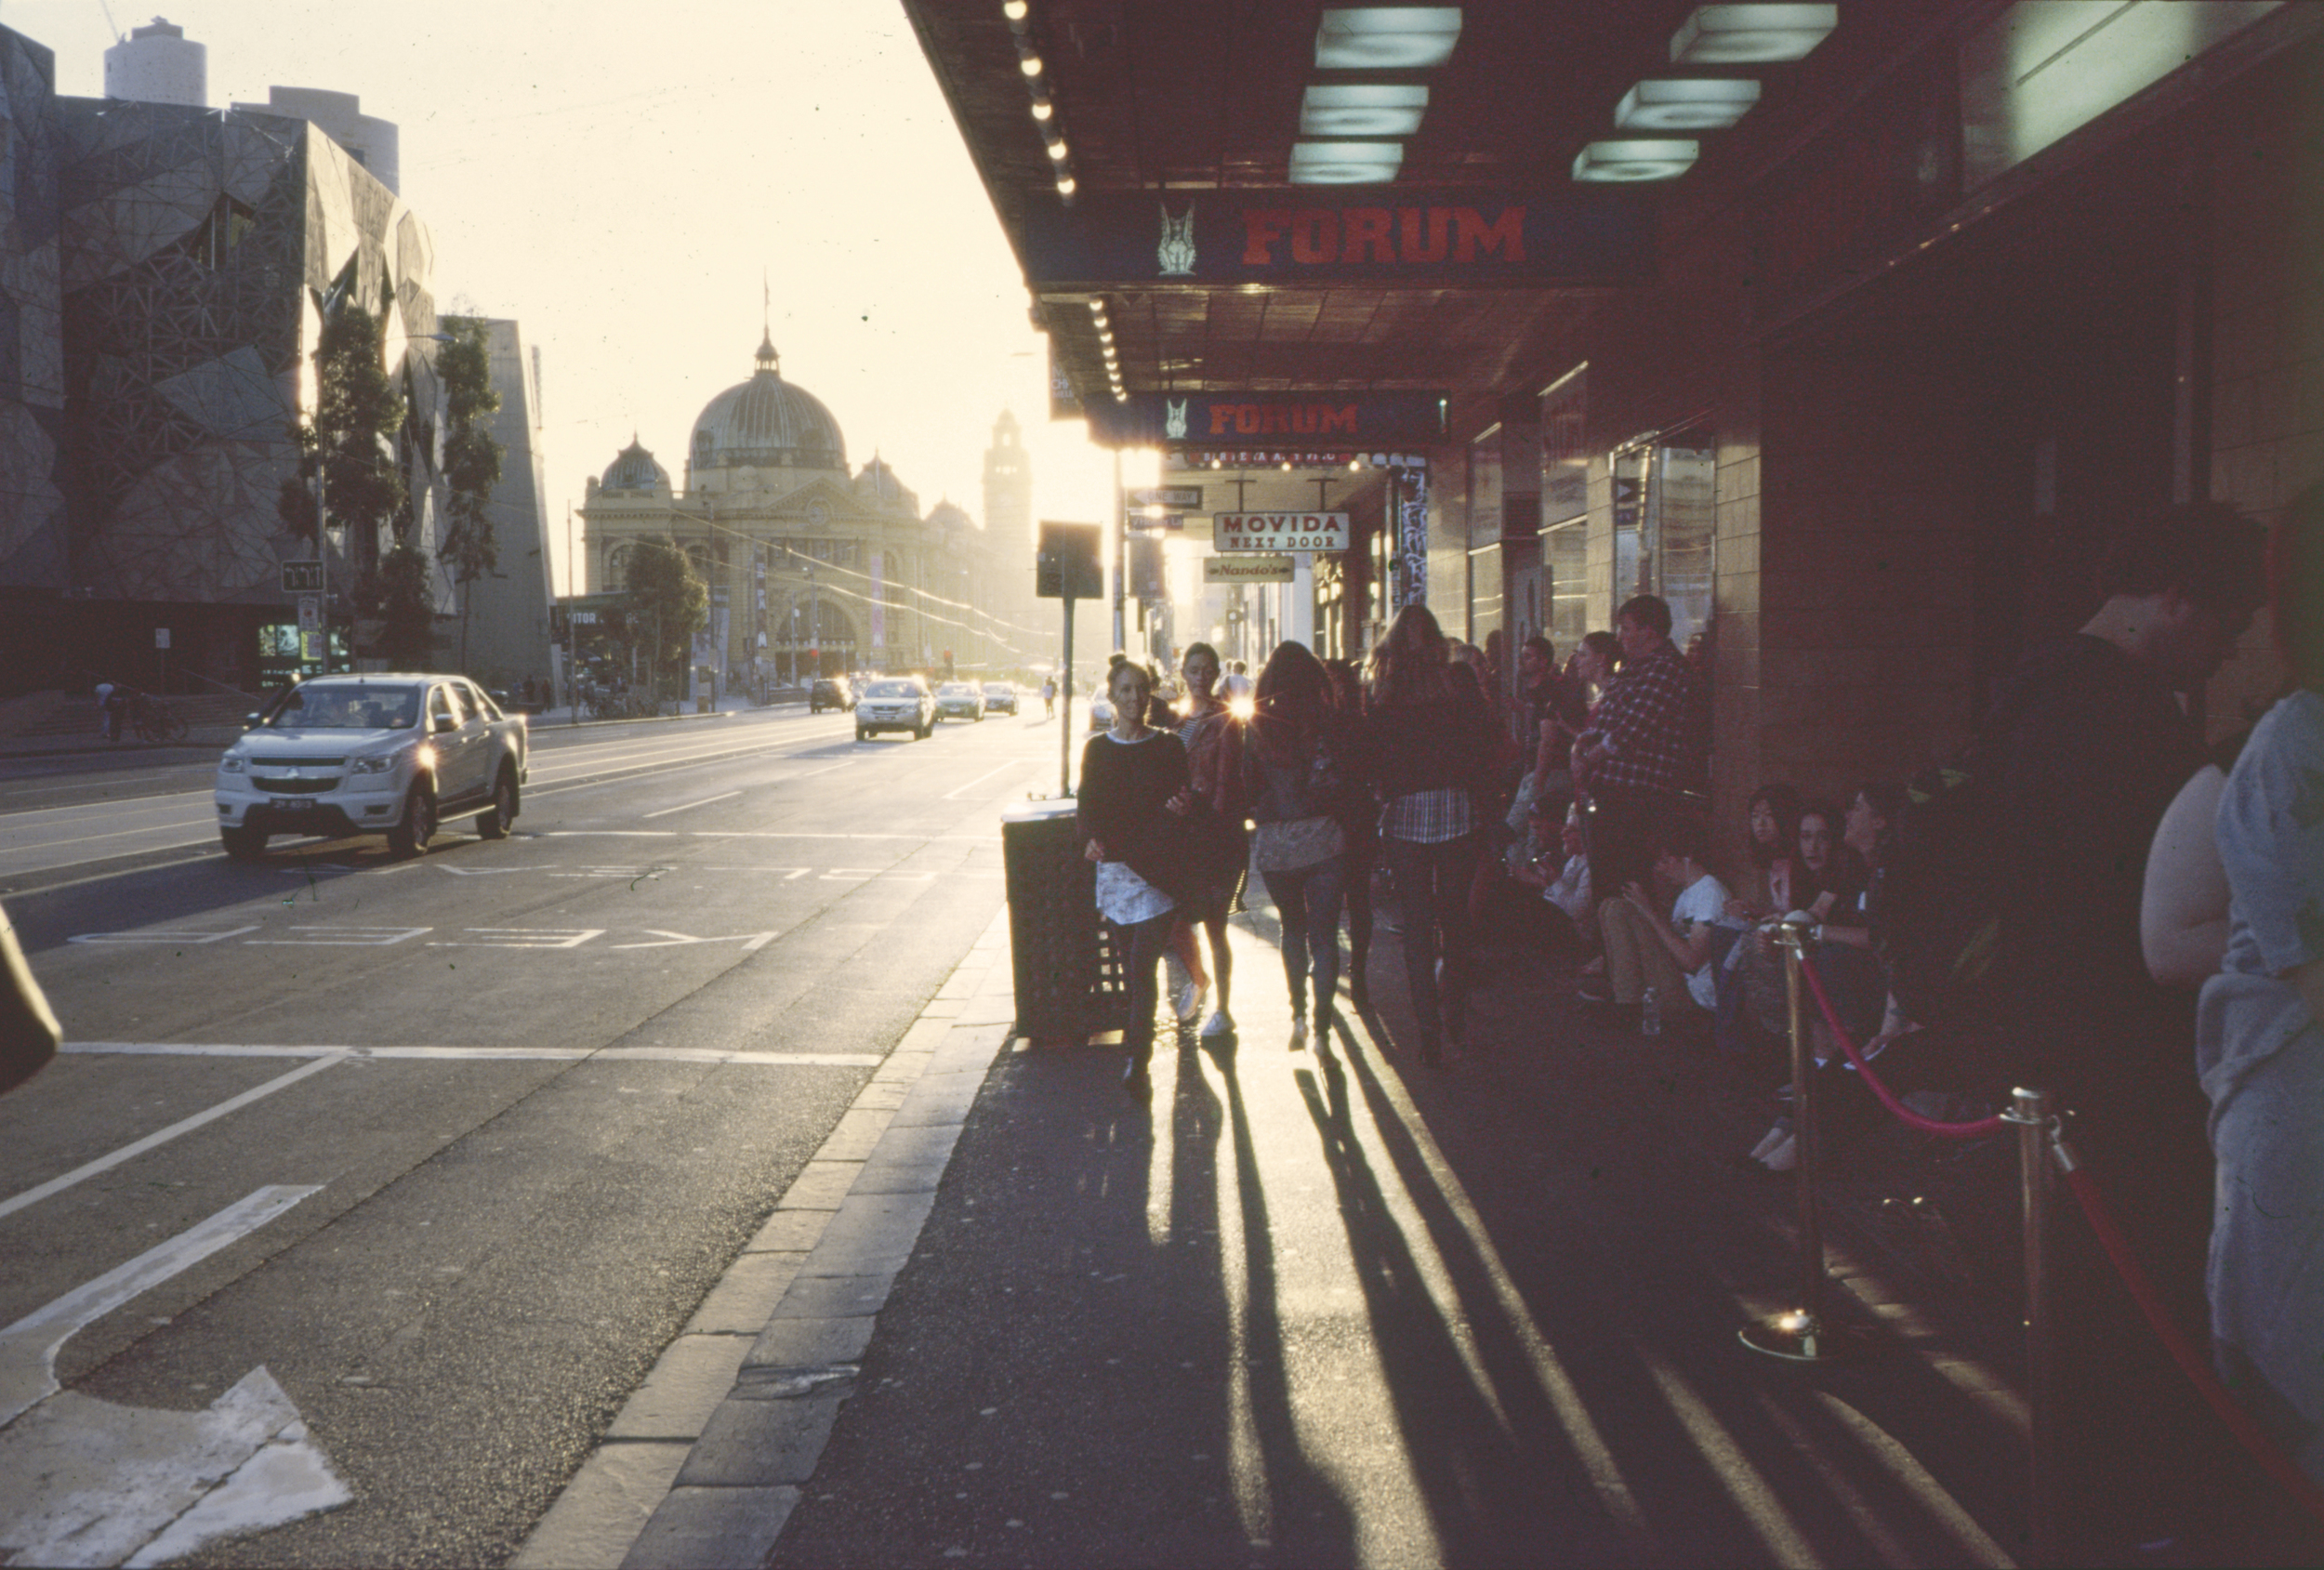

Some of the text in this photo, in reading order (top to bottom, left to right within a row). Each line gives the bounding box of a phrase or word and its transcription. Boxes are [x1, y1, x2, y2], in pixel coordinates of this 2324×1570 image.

[1242, 204, 1527, 265] FORUM
[1208, 403, 1359, 434] FORUM
[1147, 491, 1193, 501] ONE WAY
[1223, 516, 1341, 533] MOVIDA
[1230, 536, 1335, 548] NEXT DOOR
[1218, 563, 1278, 576] Nando's
